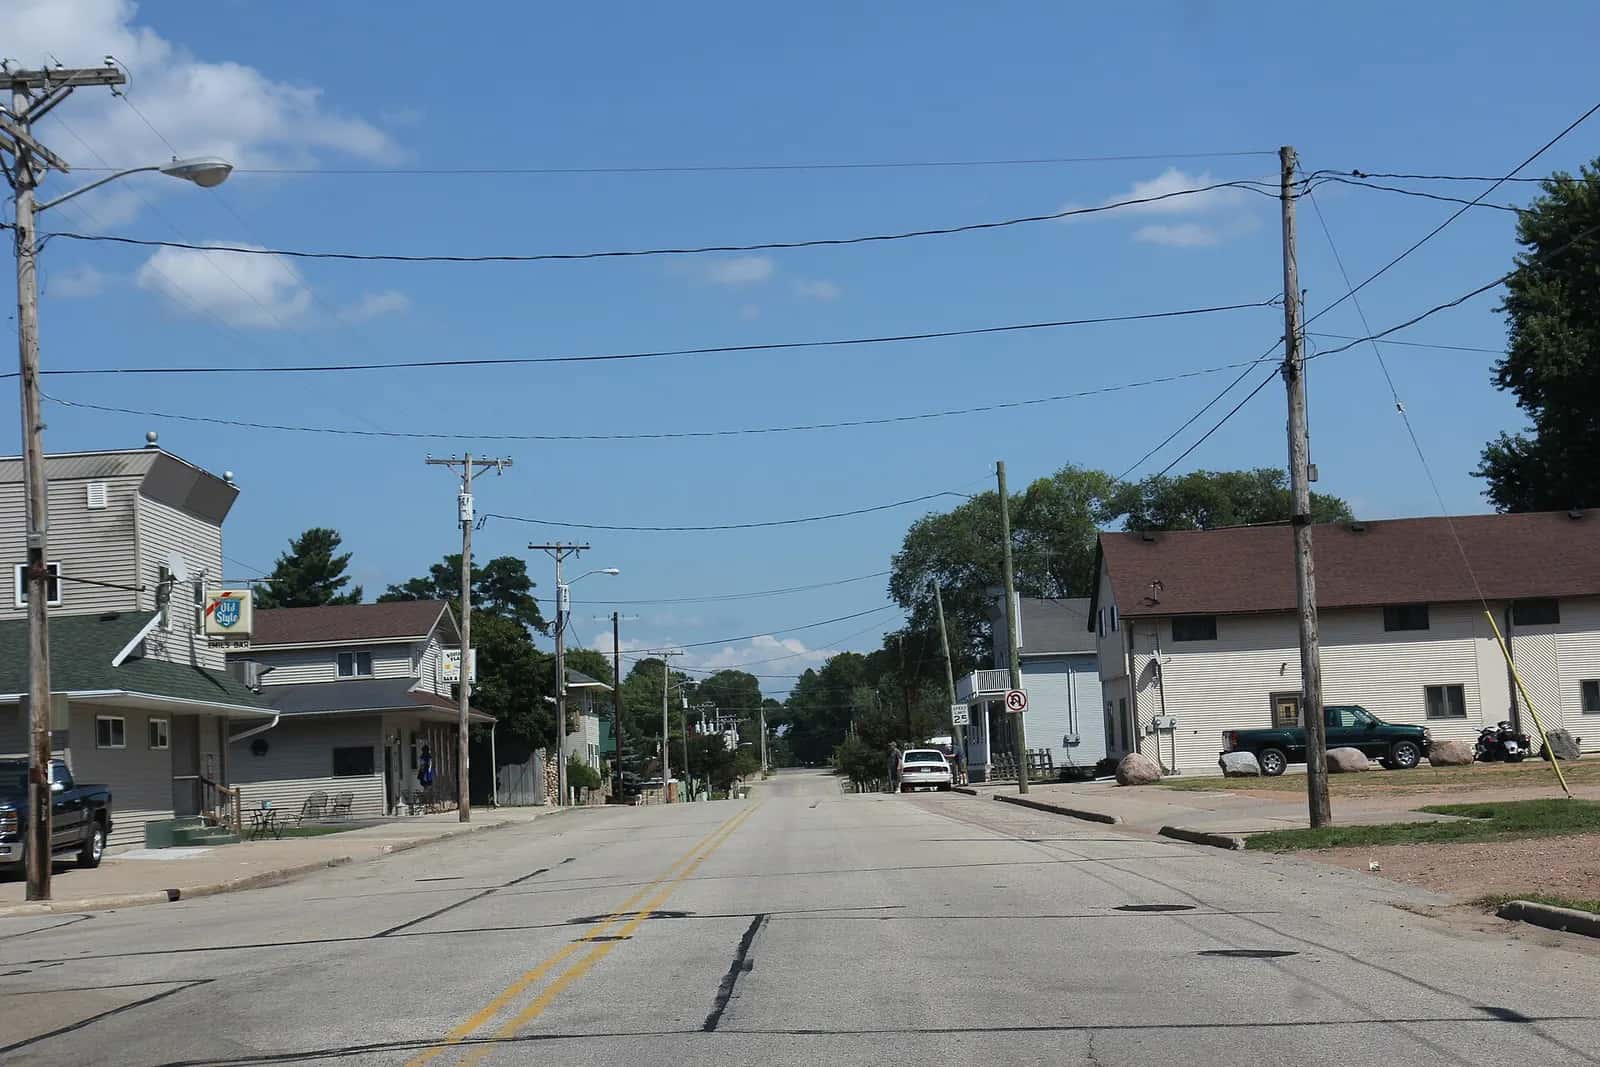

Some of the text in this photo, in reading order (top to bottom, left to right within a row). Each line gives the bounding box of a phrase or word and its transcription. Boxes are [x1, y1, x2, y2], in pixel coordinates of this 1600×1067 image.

[220, 602, 236, 612] Old
[216, 611, 239, 626] Style
[233, 641, 249, 649] BAR
[954, 714, 968, 724] 25
